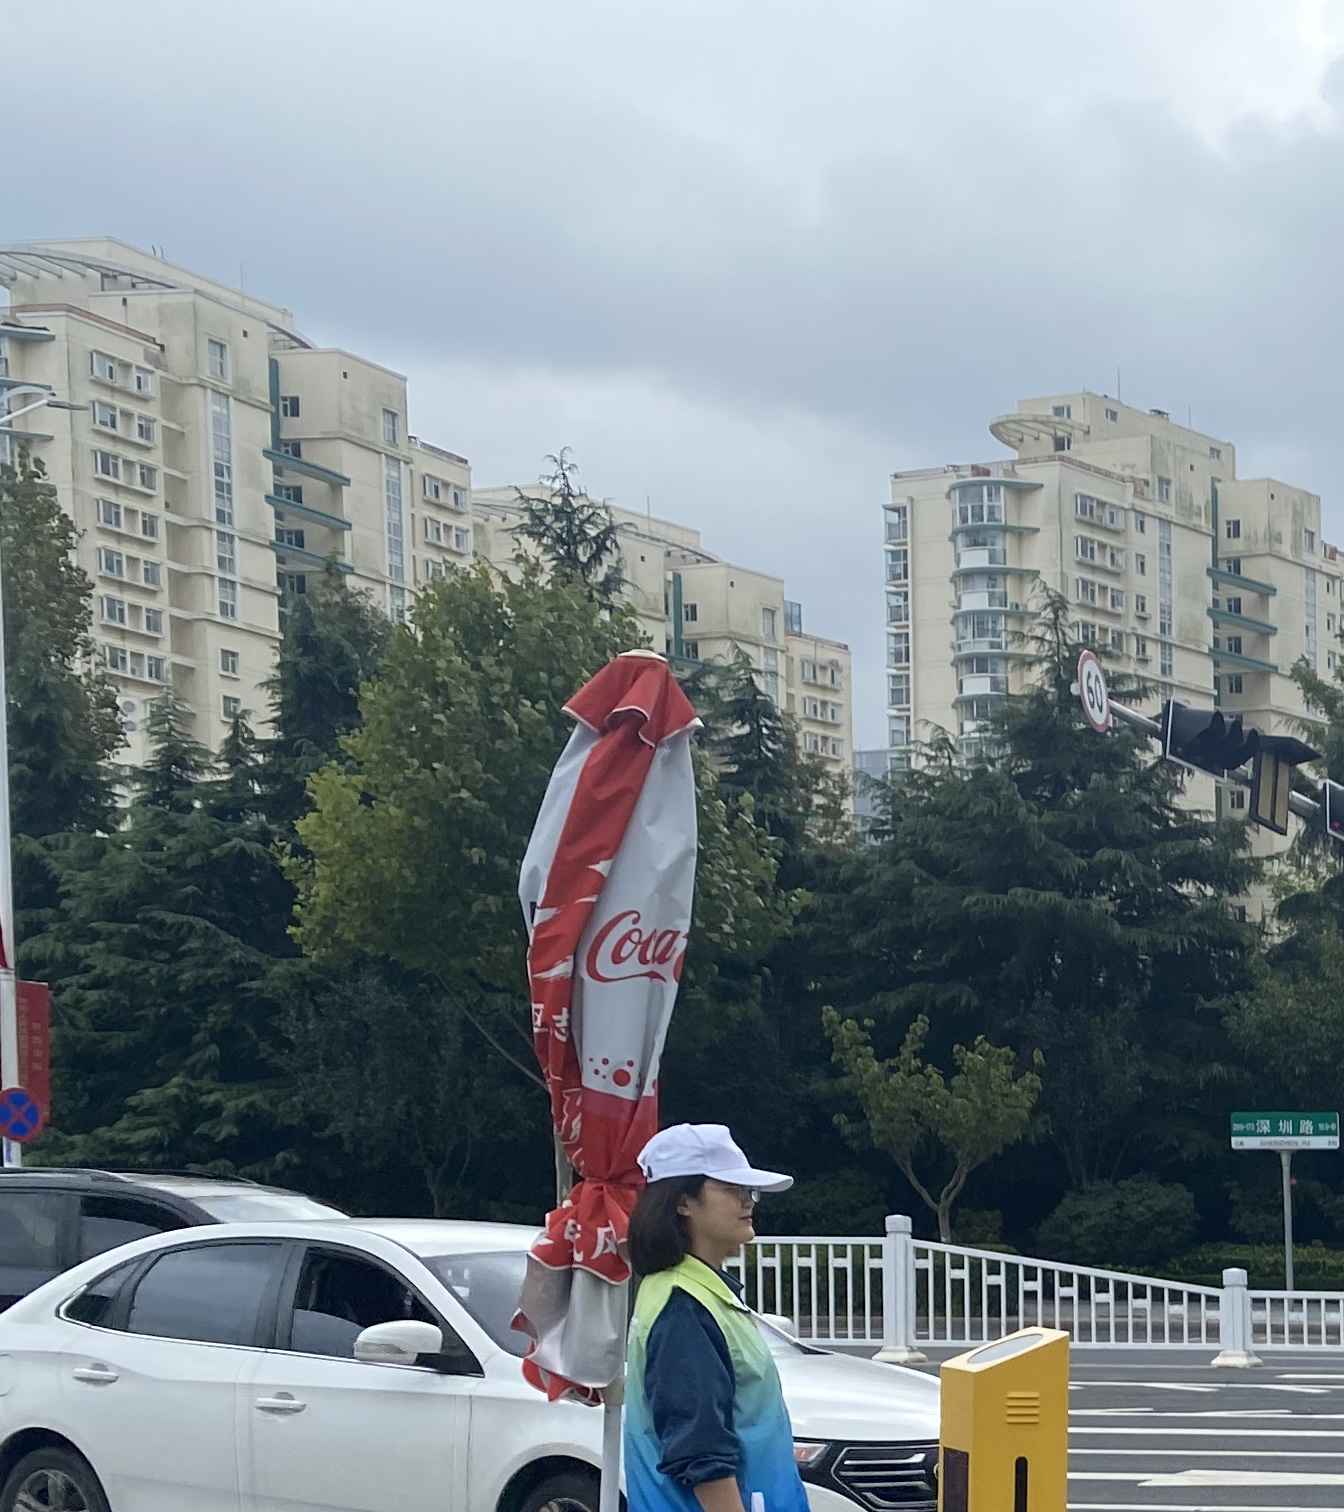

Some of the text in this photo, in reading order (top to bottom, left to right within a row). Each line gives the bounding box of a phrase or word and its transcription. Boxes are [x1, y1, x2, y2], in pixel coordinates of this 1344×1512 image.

[1086, 670, 1103, 714] 60
[1256, 1119, 1314, 1135] 深圳路
